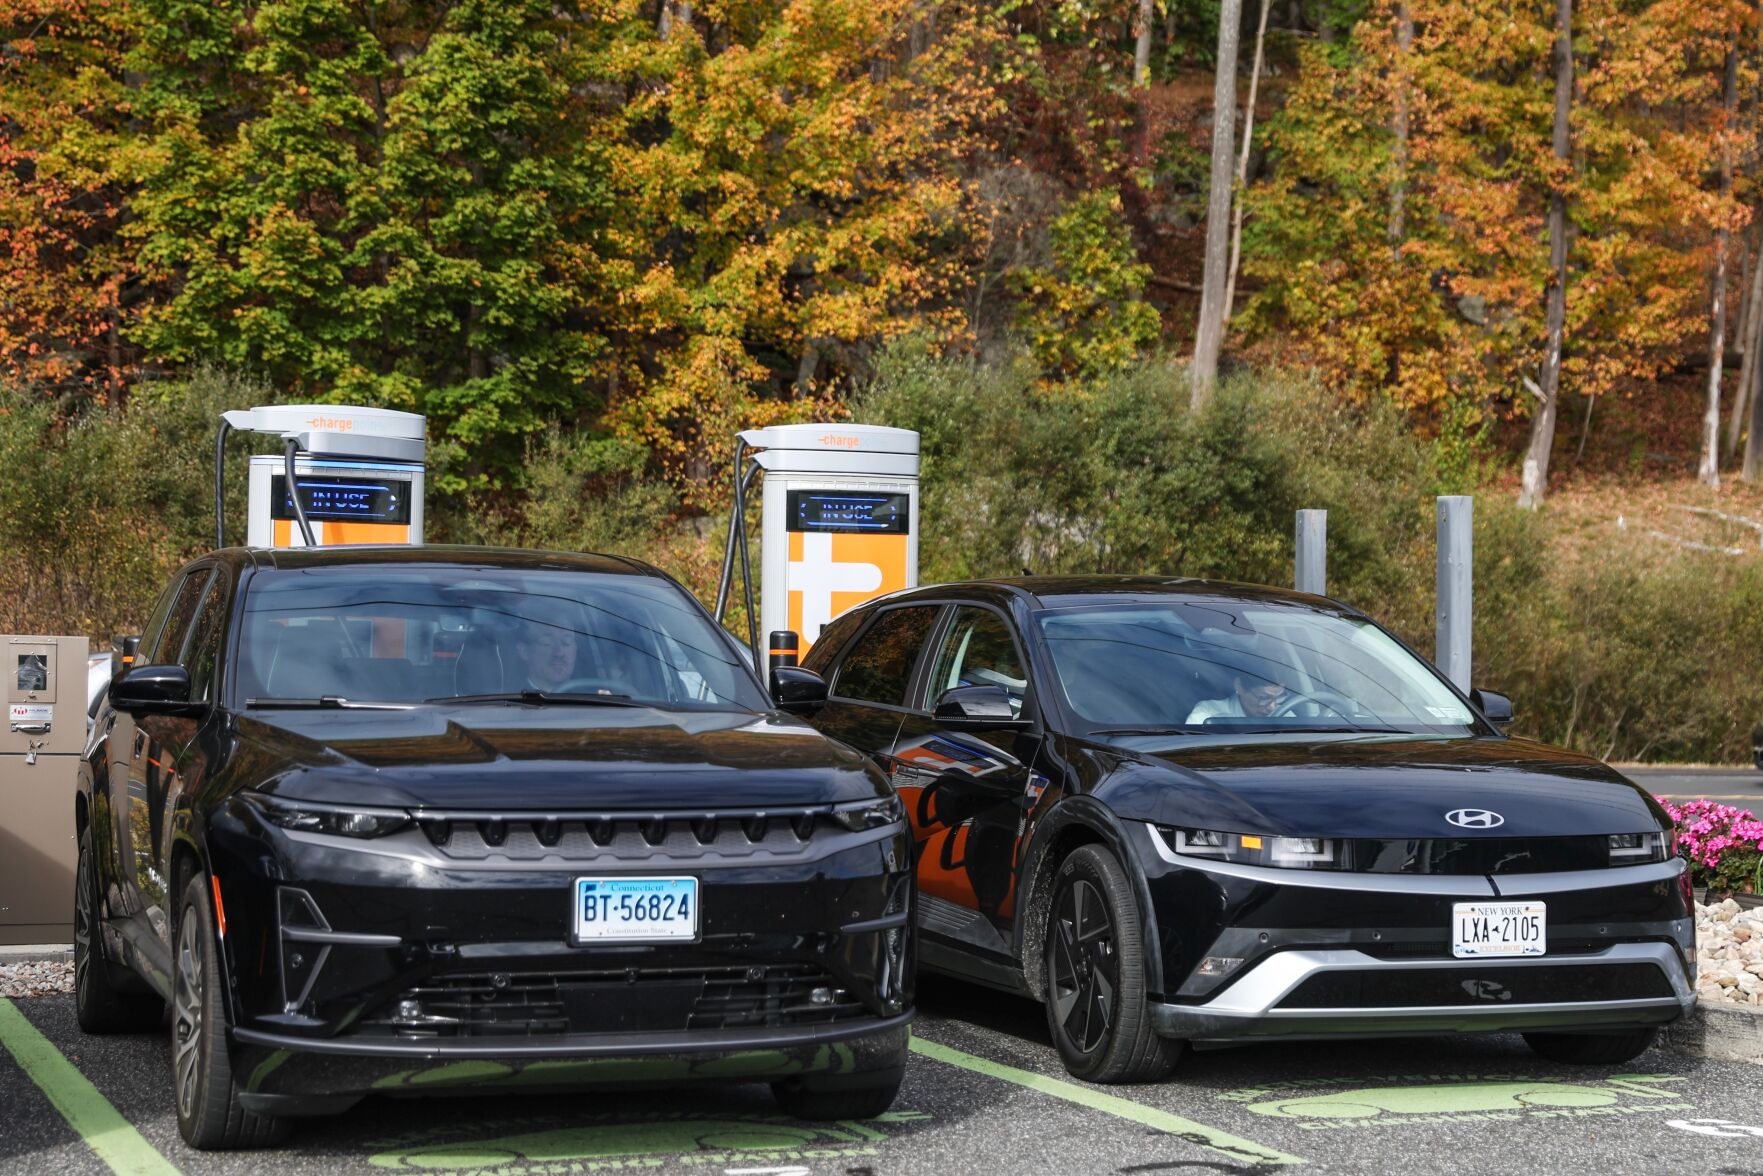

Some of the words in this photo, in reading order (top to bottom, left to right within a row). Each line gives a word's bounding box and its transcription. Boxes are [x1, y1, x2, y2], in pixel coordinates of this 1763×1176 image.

[611, 883, 664, 892] Connecticut
[1478, 907, 1498, 916] NEW
[1500, 906, 1523, 915] YORK
